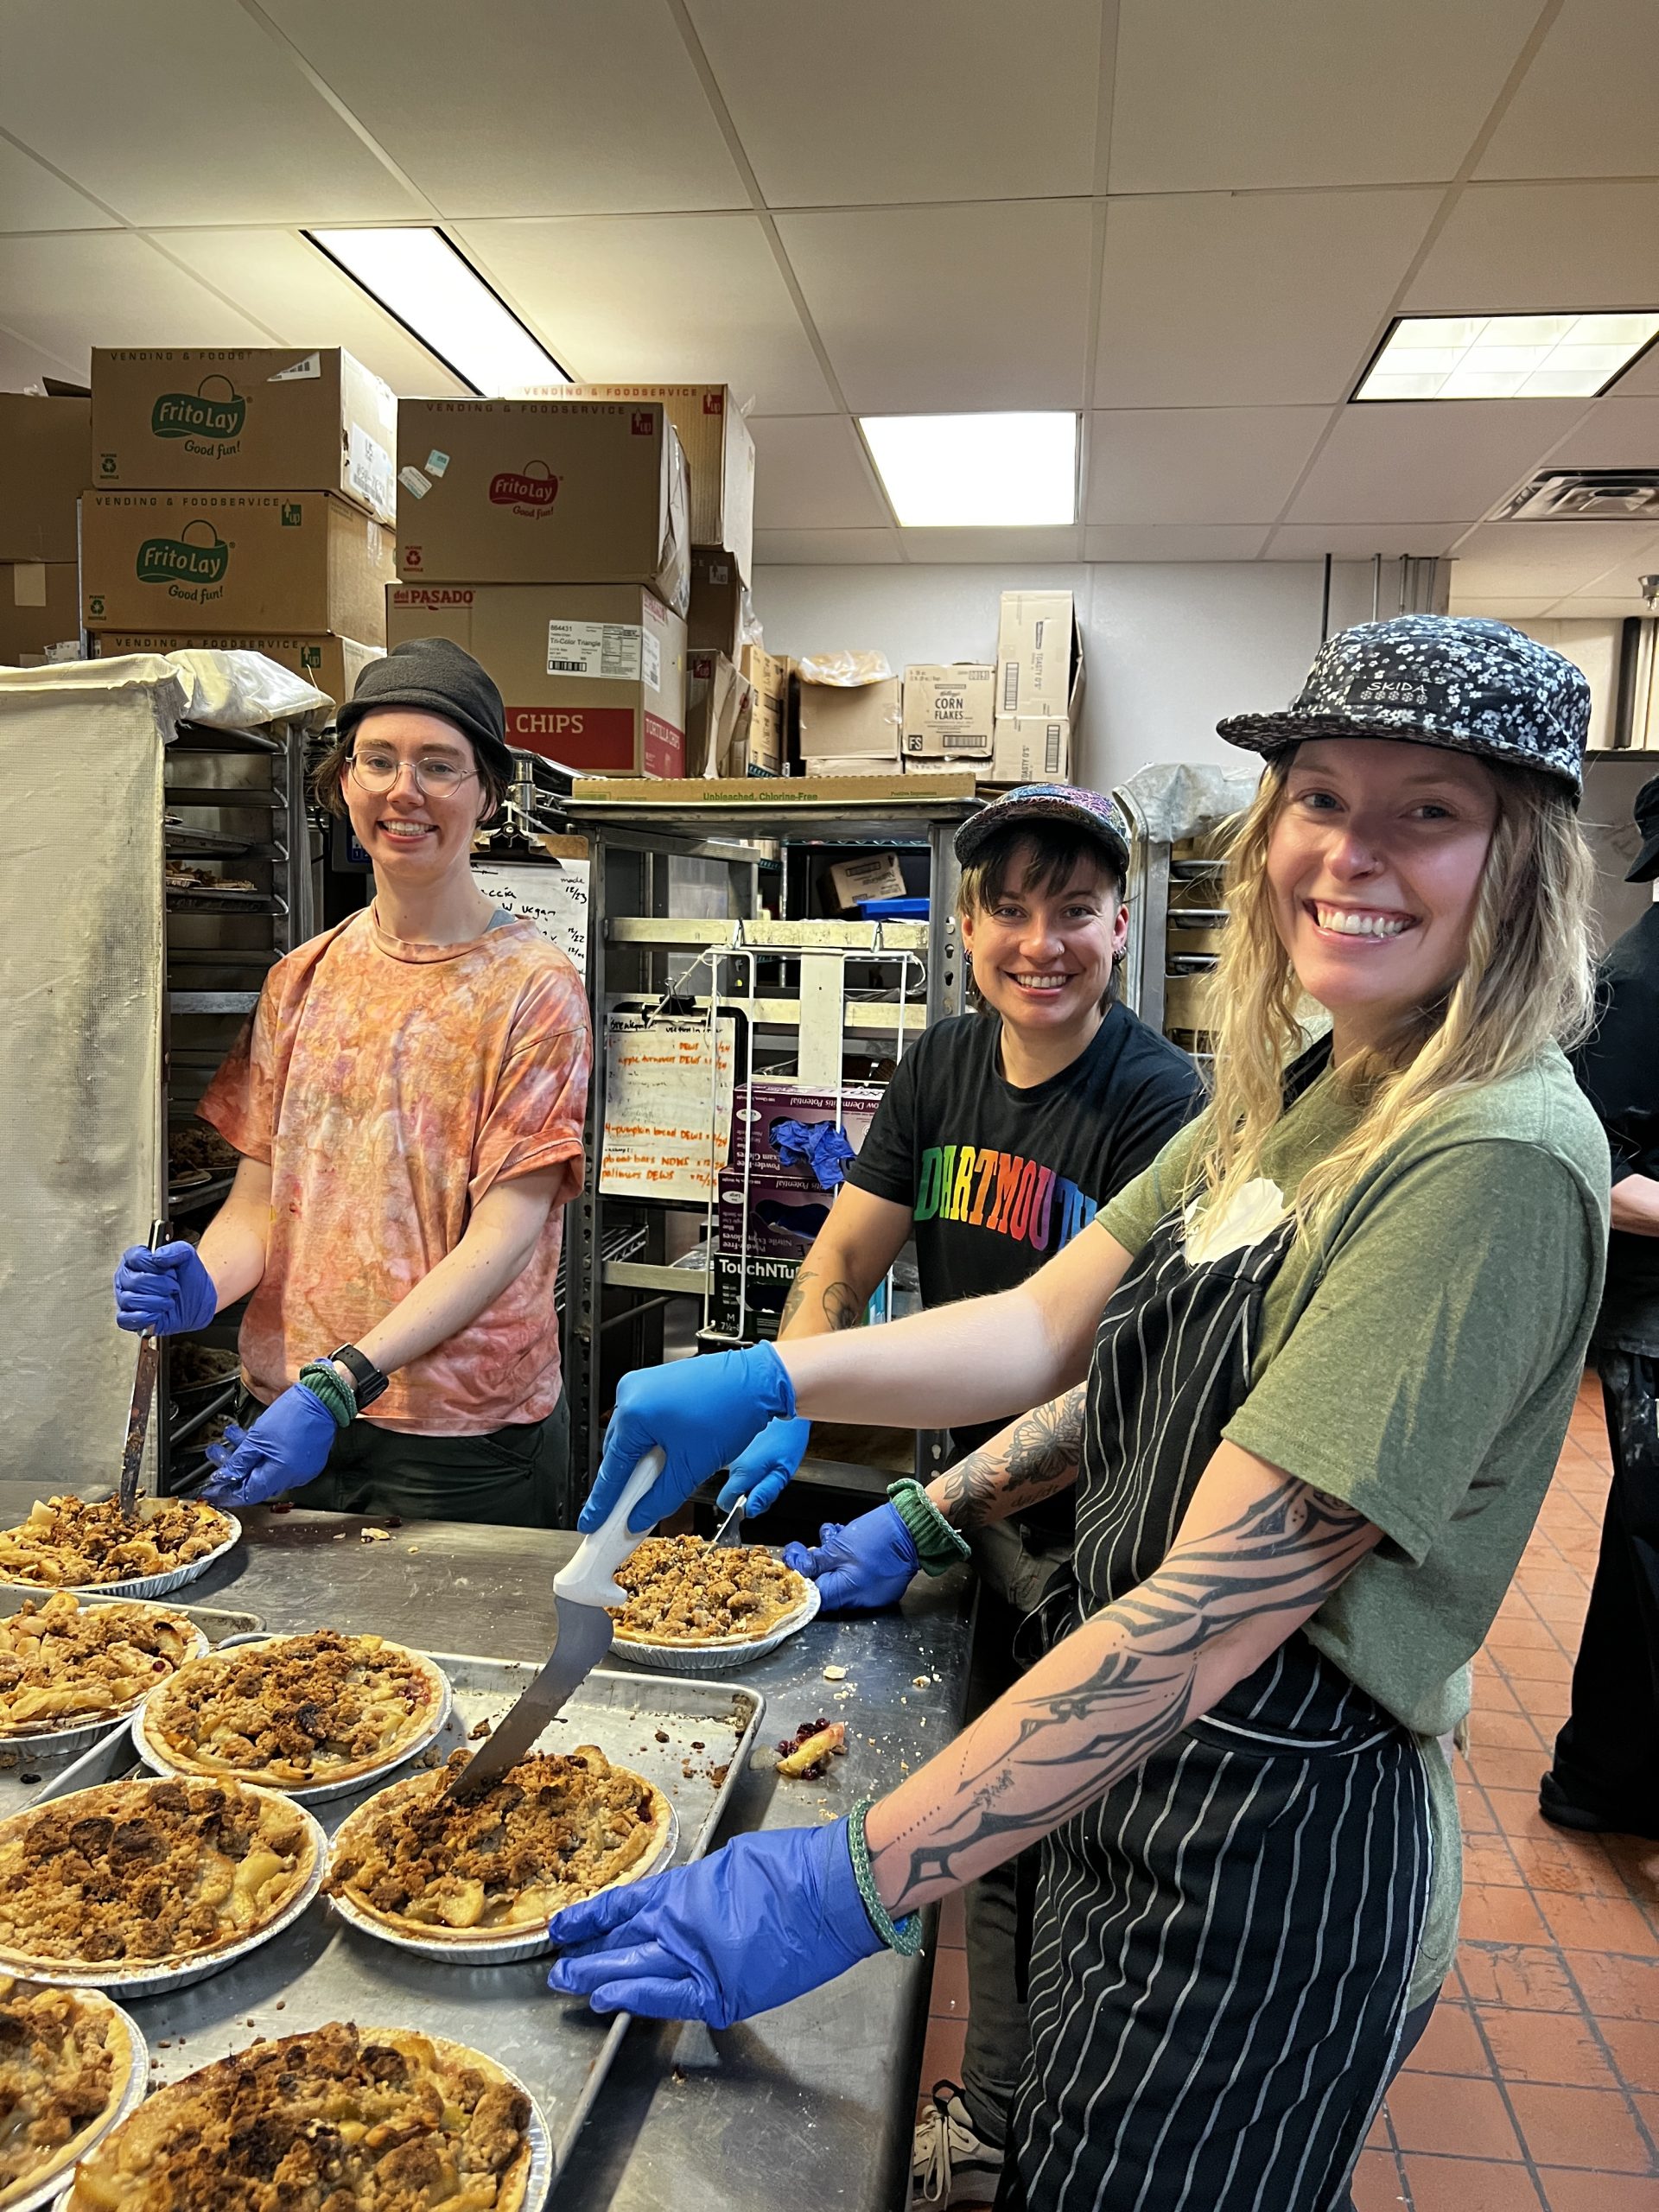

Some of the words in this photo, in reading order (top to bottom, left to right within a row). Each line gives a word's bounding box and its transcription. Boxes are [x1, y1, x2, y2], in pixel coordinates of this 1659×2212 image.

[111, 352, 174, 361] VENDING
[182, 352, 190, 361] &
[524, 387, 582, 397] VENDING
[590, 388, 598, 397] &
[606, 388, 698, 397] FOODSERVICE
[427, 404, 493, 413] VENDING
[503, 404, 511, 413] &
[521, 404, 626, 415] FOODSERVICE
[184, 440, 214, 456] Good
[216, 441, 241, 461] fun!
[95, 497, 157, 506] VENDING
[166, 498, 174, 506] &
[182, 497, 279, 507] FOODSERVICE
[512, 505, 536, 518] Good
[536, 505, 554, 520] fun!
[289, 512, 301, 525] up
[168, 584, 198, 601] Good
[200, 585, 224, 605] fun!
[410, 590, 474, 603] PASADO
[116, 638, 177, 648] VENDING
[186, 639, 194, 648] &
[203, 639, 299, 649] FOODSERVICE
[1367, 682, 1427, 695] SKIDA
[935, 698, 963, 709] CORN
[935, 710, 963, 720] FLAKES
[516, 714, 584, 734] CHIPS
[909, 736, 922, 751] FS
[702, 791, 756, 802] Unbleached,
[759, 791, 818, 801] Chlorine-Free
[790, 1096, 823, 1107] Potential
[775, 1179, 809, 1190] Potential
[722, 1232, 744, 1242] loves
